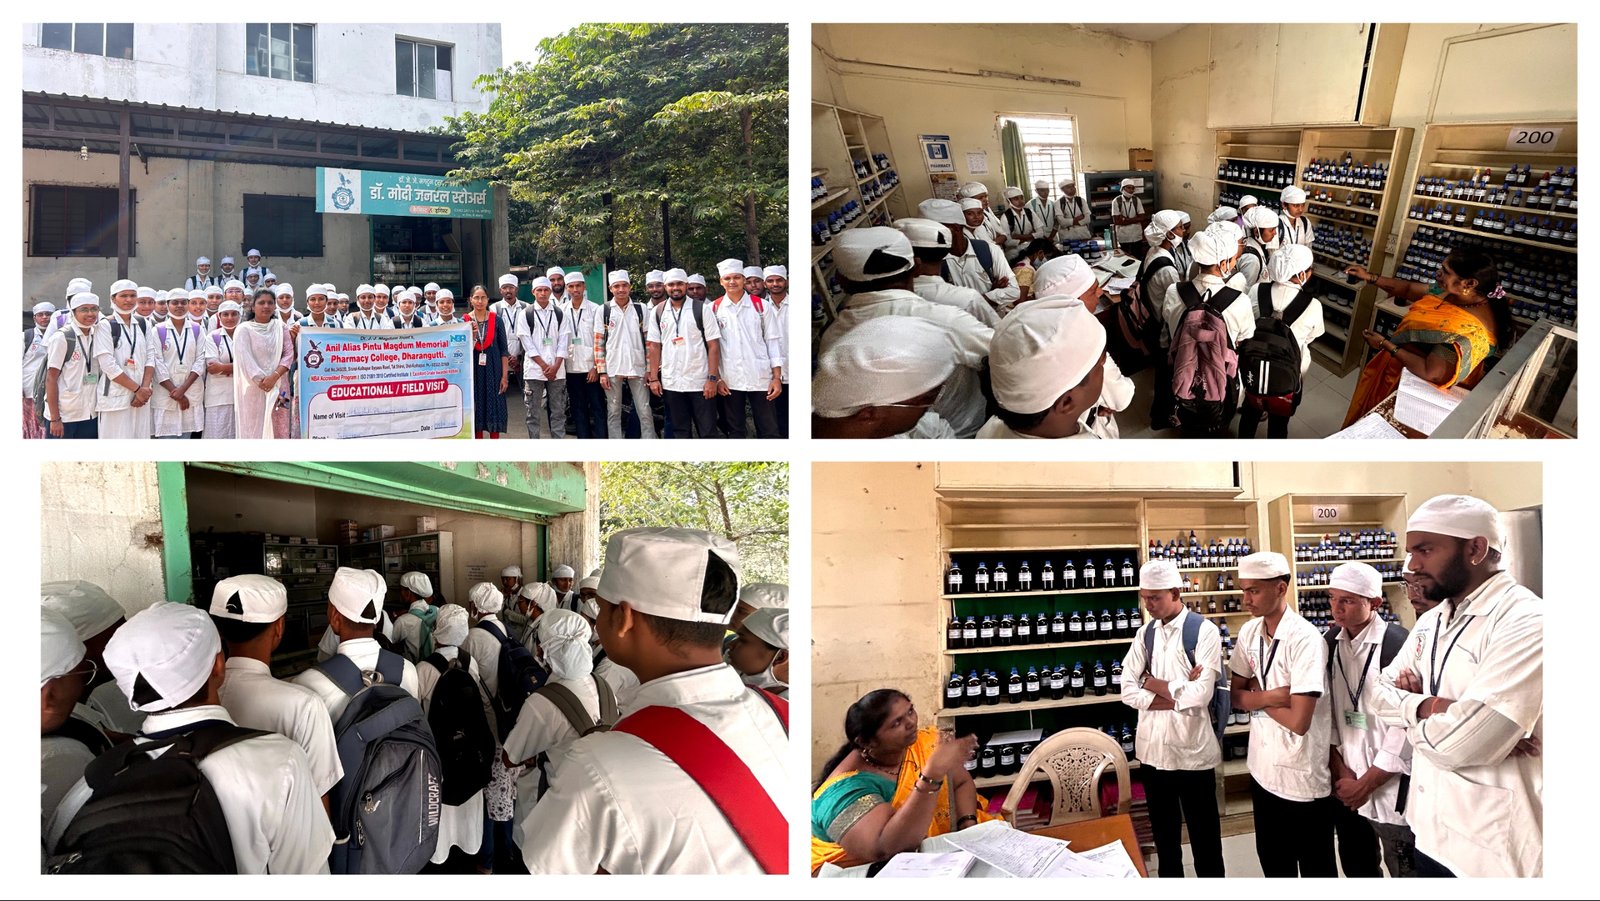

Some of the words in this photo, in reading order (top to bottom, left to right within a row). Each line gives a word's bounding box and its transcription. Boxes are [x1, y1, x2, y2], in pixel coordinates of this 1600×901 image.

[1516, 131, 1554, 144] 200
[369, 182, 384, 200] डॉ.
[387, 184, 412, 201] मोदी
[414, 188, 450, 203] जनरल
[452, 188, 487, 205] स्टोअर्स
[326, 344, 340, 352] Anil
[342, 343, 361, 352] Alias
[362, 342, 382, 350] Pintu
[384, 342, 414, 350] Magdum
[416, 340, 448, 349] Memorial
[331, 354, 368, 364] Pharmacy
[370, 354, 400, 362] College,
[402, 351, 446, 360] Dharangutti.
[331, 385, 394, 398] EDUCATIONAL
[396, 384, 400, 394] /
[402, 382, 424, 394] FIELD
[426, 381, 445, 392] VISIT
[1318, 509, 1336, 518] 200
[428, 773, 440, 827] WILDCRAFT
